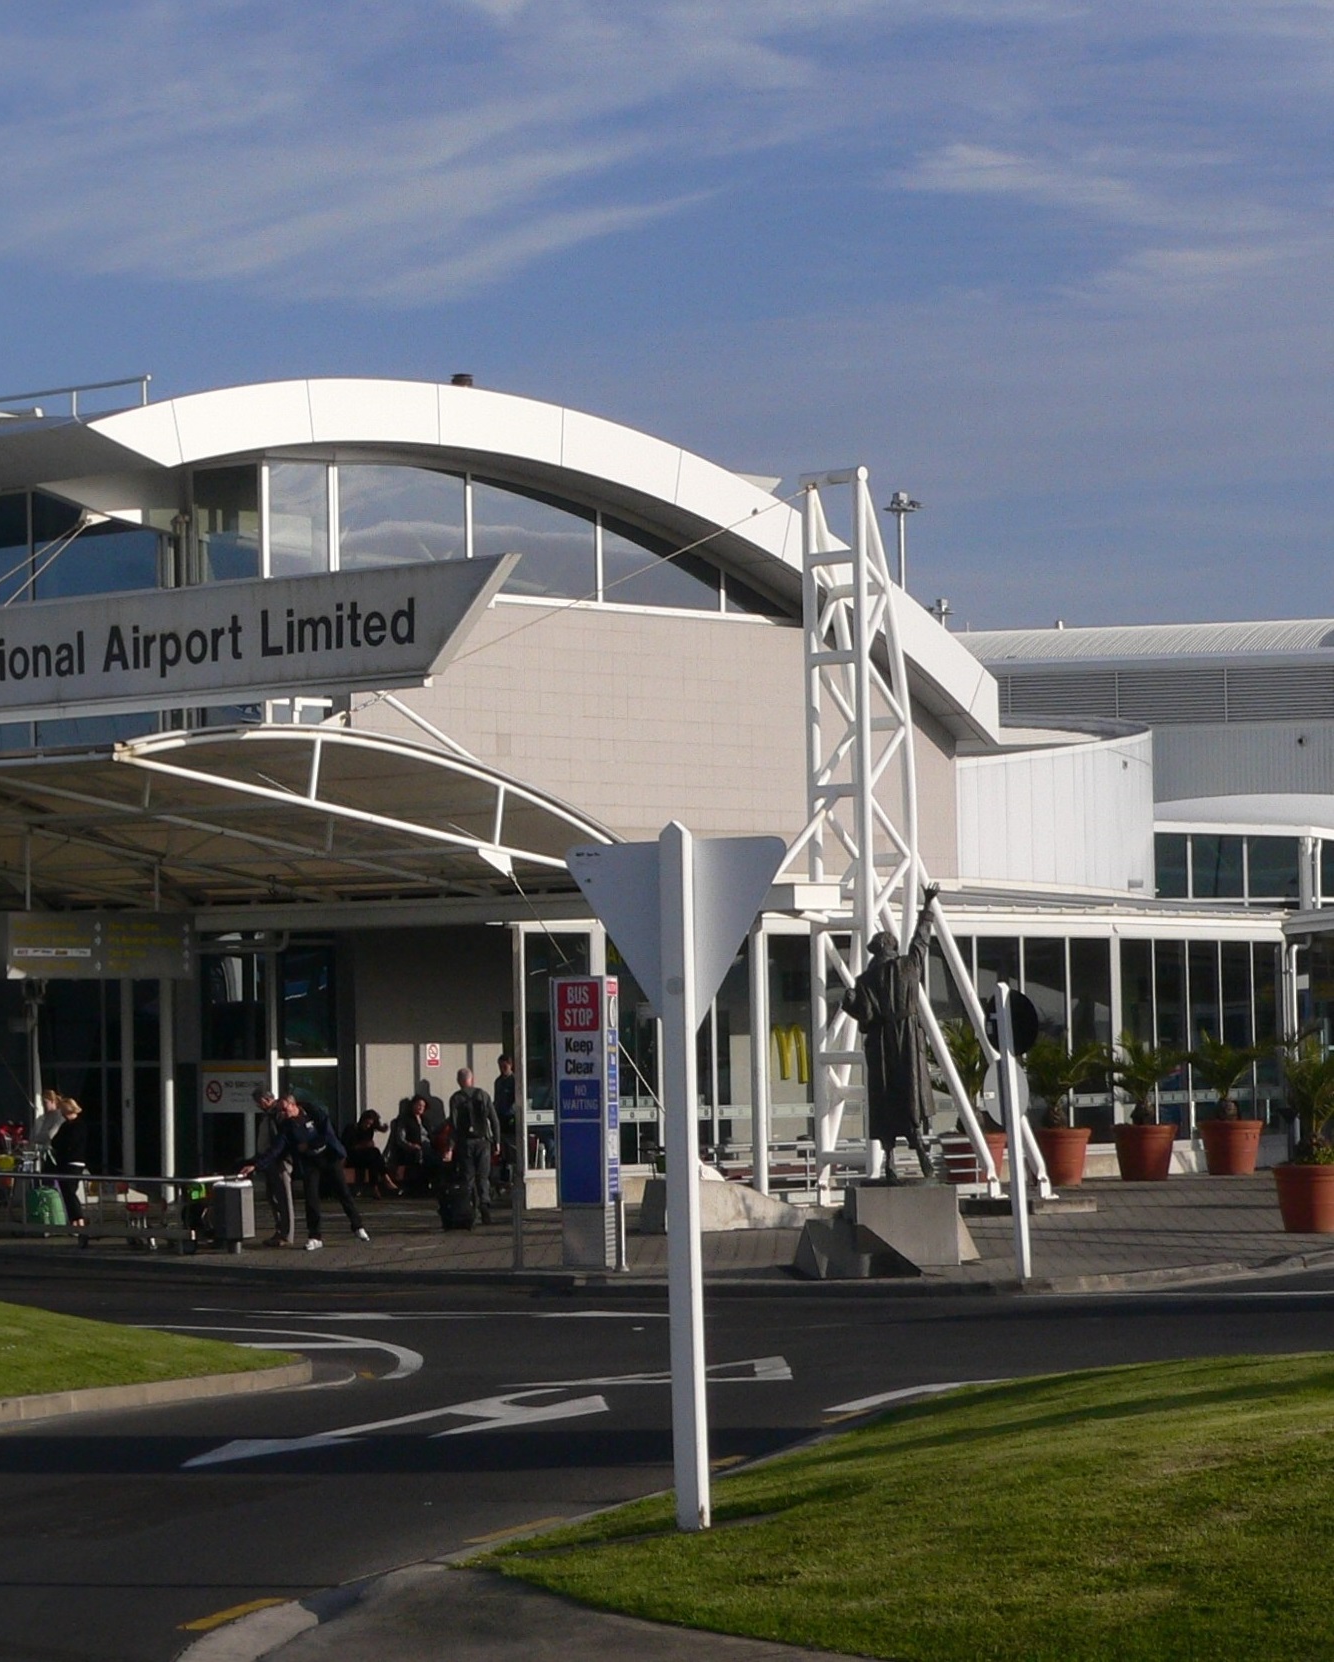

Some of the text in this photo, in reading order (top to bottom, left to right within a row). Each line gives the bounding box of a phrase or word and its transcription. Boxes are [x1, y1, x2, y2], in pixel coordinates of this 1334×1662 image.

[103, 614, 242, 677] Airport
[260, 597, 416, 658] Limited
[566, 985, 590, 1005] BUS
[564, 1008, 593, 1027] STOP
[565, 1037, 594, 1055] Keep
[565, 1058, 595, 1075] Clear
[574, 1084, 587, 1097] NO
[562, 1098, 599, 1111] WAITING
